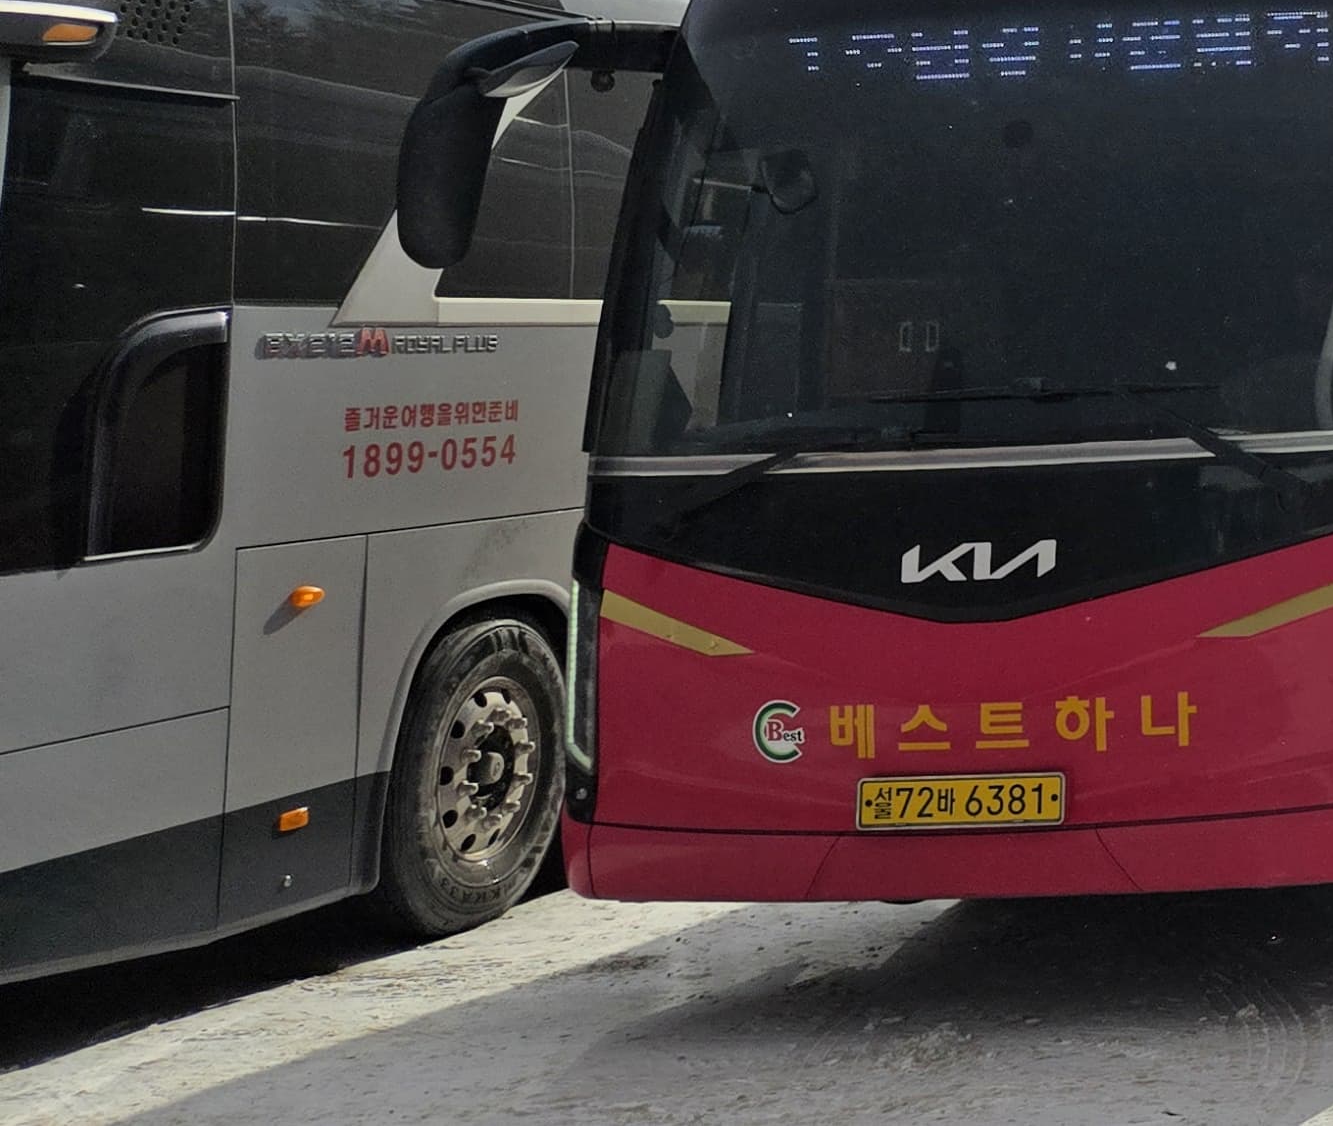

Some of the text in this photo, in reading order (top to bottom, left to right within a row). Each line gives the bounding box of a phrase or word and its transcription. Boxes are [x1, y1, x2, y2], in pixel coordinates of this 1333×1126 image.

[392, 334, 452, 355] ROYAL
[453, 333, 498, 354] PLUS
[343, 434, 516, 479] 1899-0554
[901, 539, 1056, 584] KIA
[964, 783, 1044, 817] 6381
